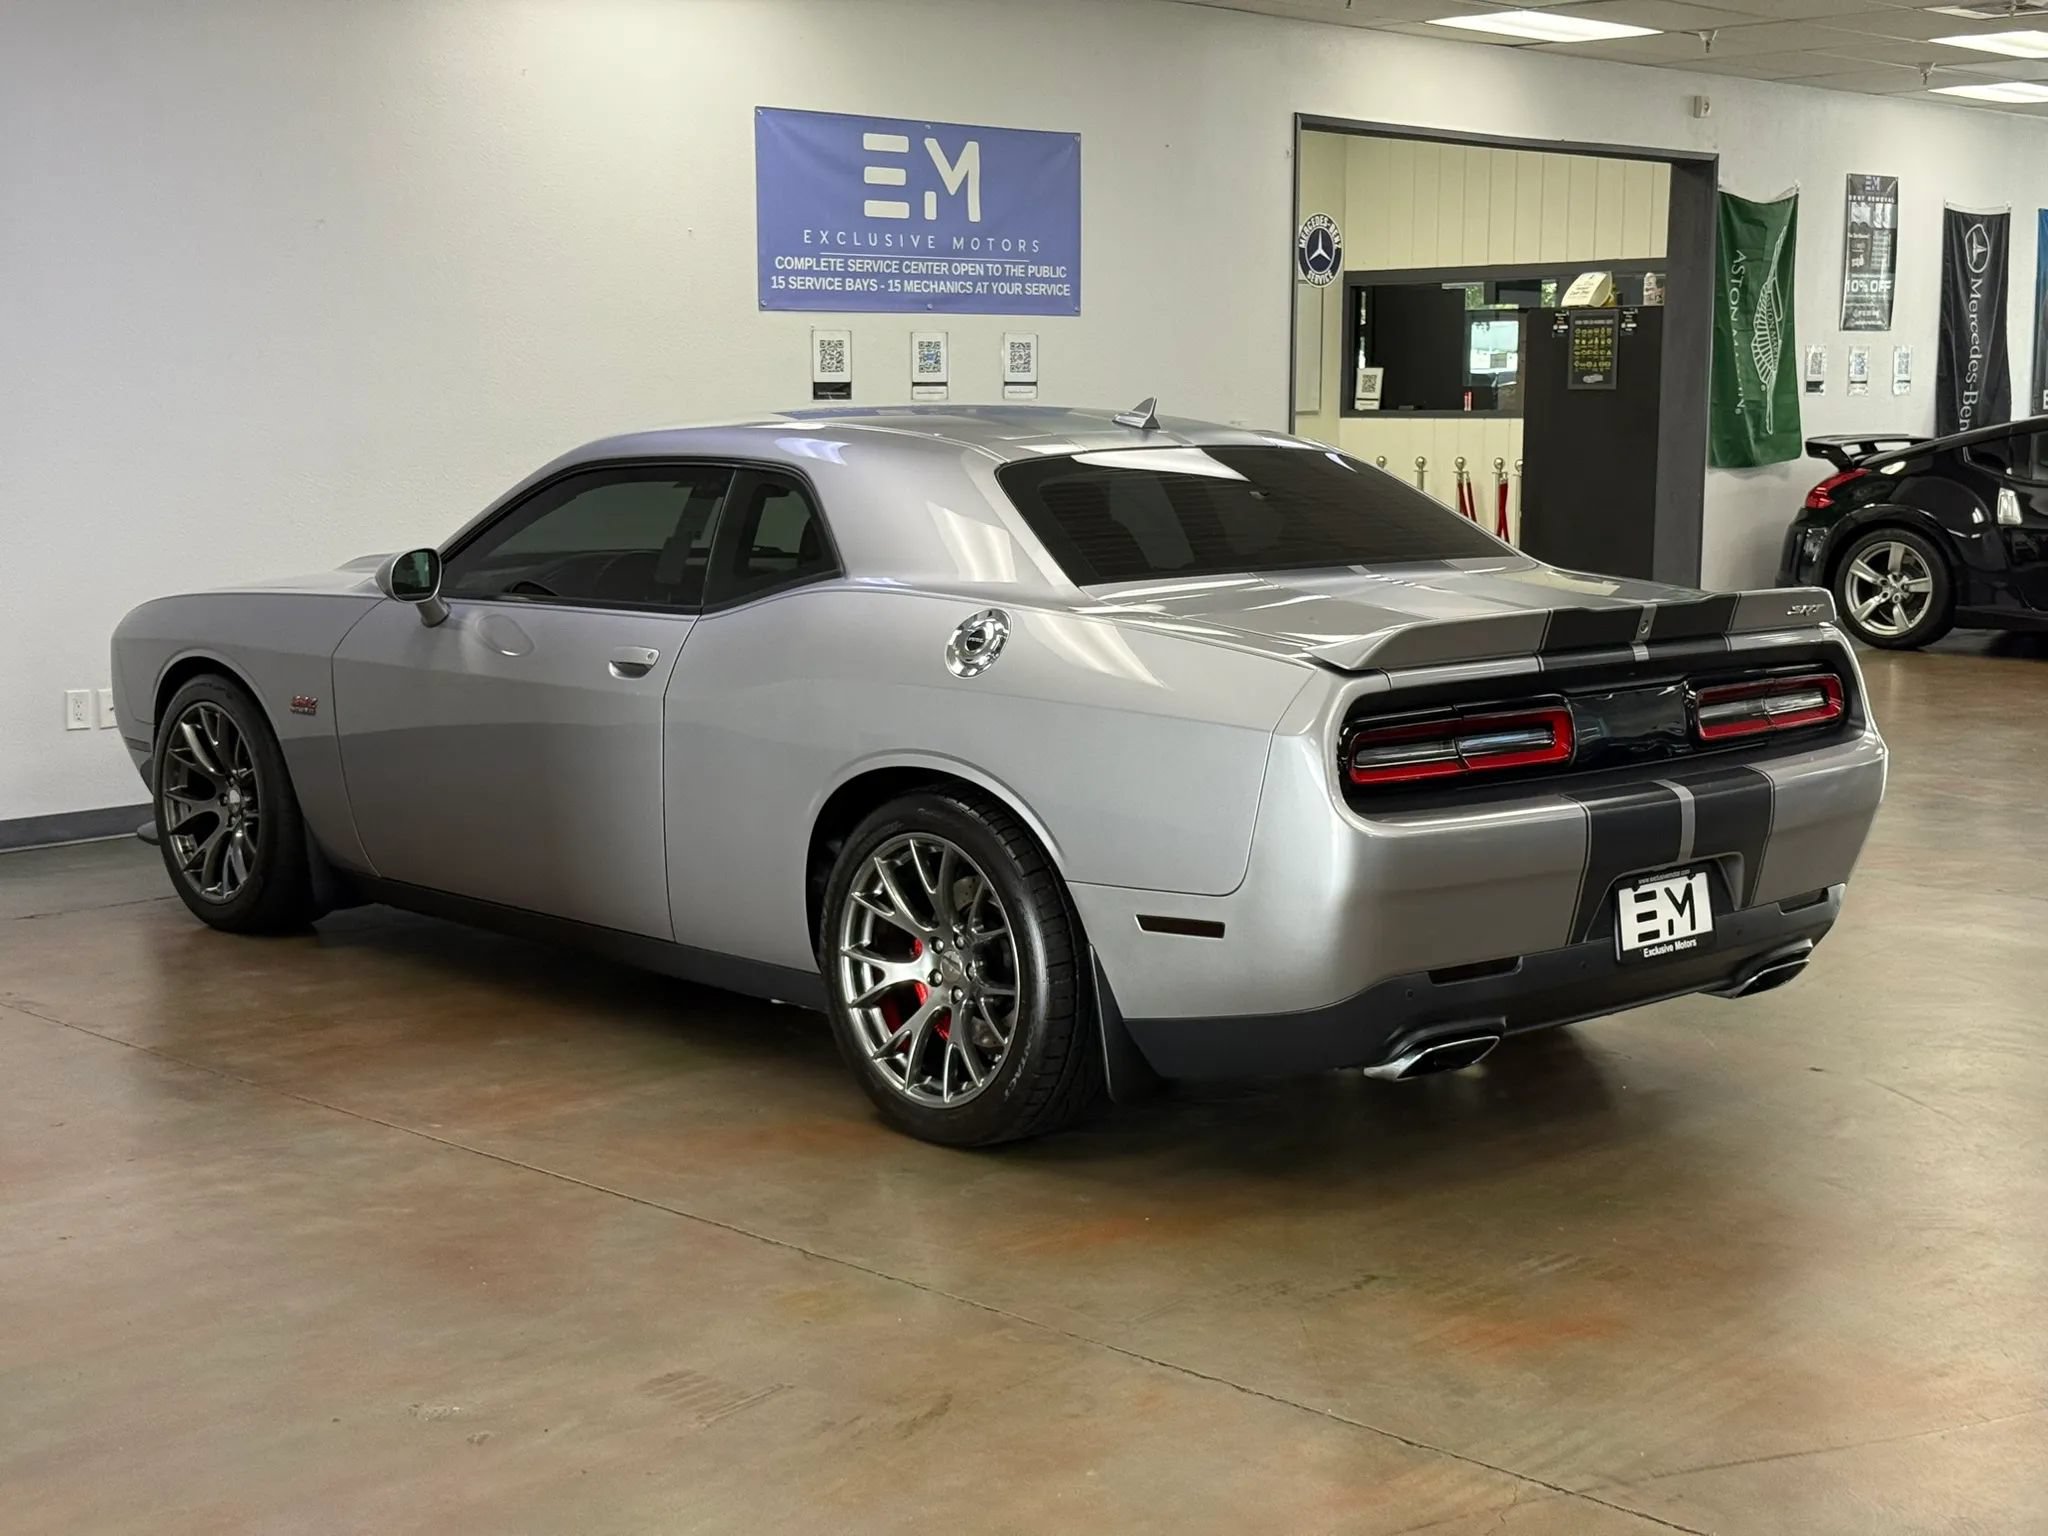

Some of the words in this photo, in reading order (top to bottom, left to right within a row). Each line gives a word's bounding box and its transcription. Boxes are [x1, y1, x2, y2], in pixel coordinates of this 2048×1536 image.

[863, 132, 981, 222] EM
[803, 229, 935, 249] EXCLUSIVE
[952, 236, 1040, 253] MOTORS
[1298, 215, 1342, 249] MERCEDES-BENZ
[775, 256, 845, 272] COMPLETE
[847, 259, 900, 273] SERVICE
[902, 261, 949, 275] CENTER
[951, 262, 984, 276] OPEN
[986, 263, 1001, 276] TO
[1003, 264, 1025, 277] THE
[1028, 265, 1067, 278] PUBLIC
[1307, 269, 1334, 285] SERVICE
[771, 276, 786, 289] 15
[788, 276, 842, 290] SERVICE
[845, 278, 878, 291] BAYS
[887, 279, 900, 292] 15
[904, 280, 973, 294] MECHANICS
[975, 281, 989, 294] AT
[991, 282, 1023, 295] YOUR
[1025, 283, 1071, 296] SERVICE
[1729, 249, 1747, 321] ASTON
[1870, 280, 1892, 293] OFF
[1959, 278, 1984, 431] Mercedes-Ben
[1634, 882, 1696, 943] EM
[1643, 942, 1674, 958] Exclusive
[1674, 939, 1697, 951] Motors
